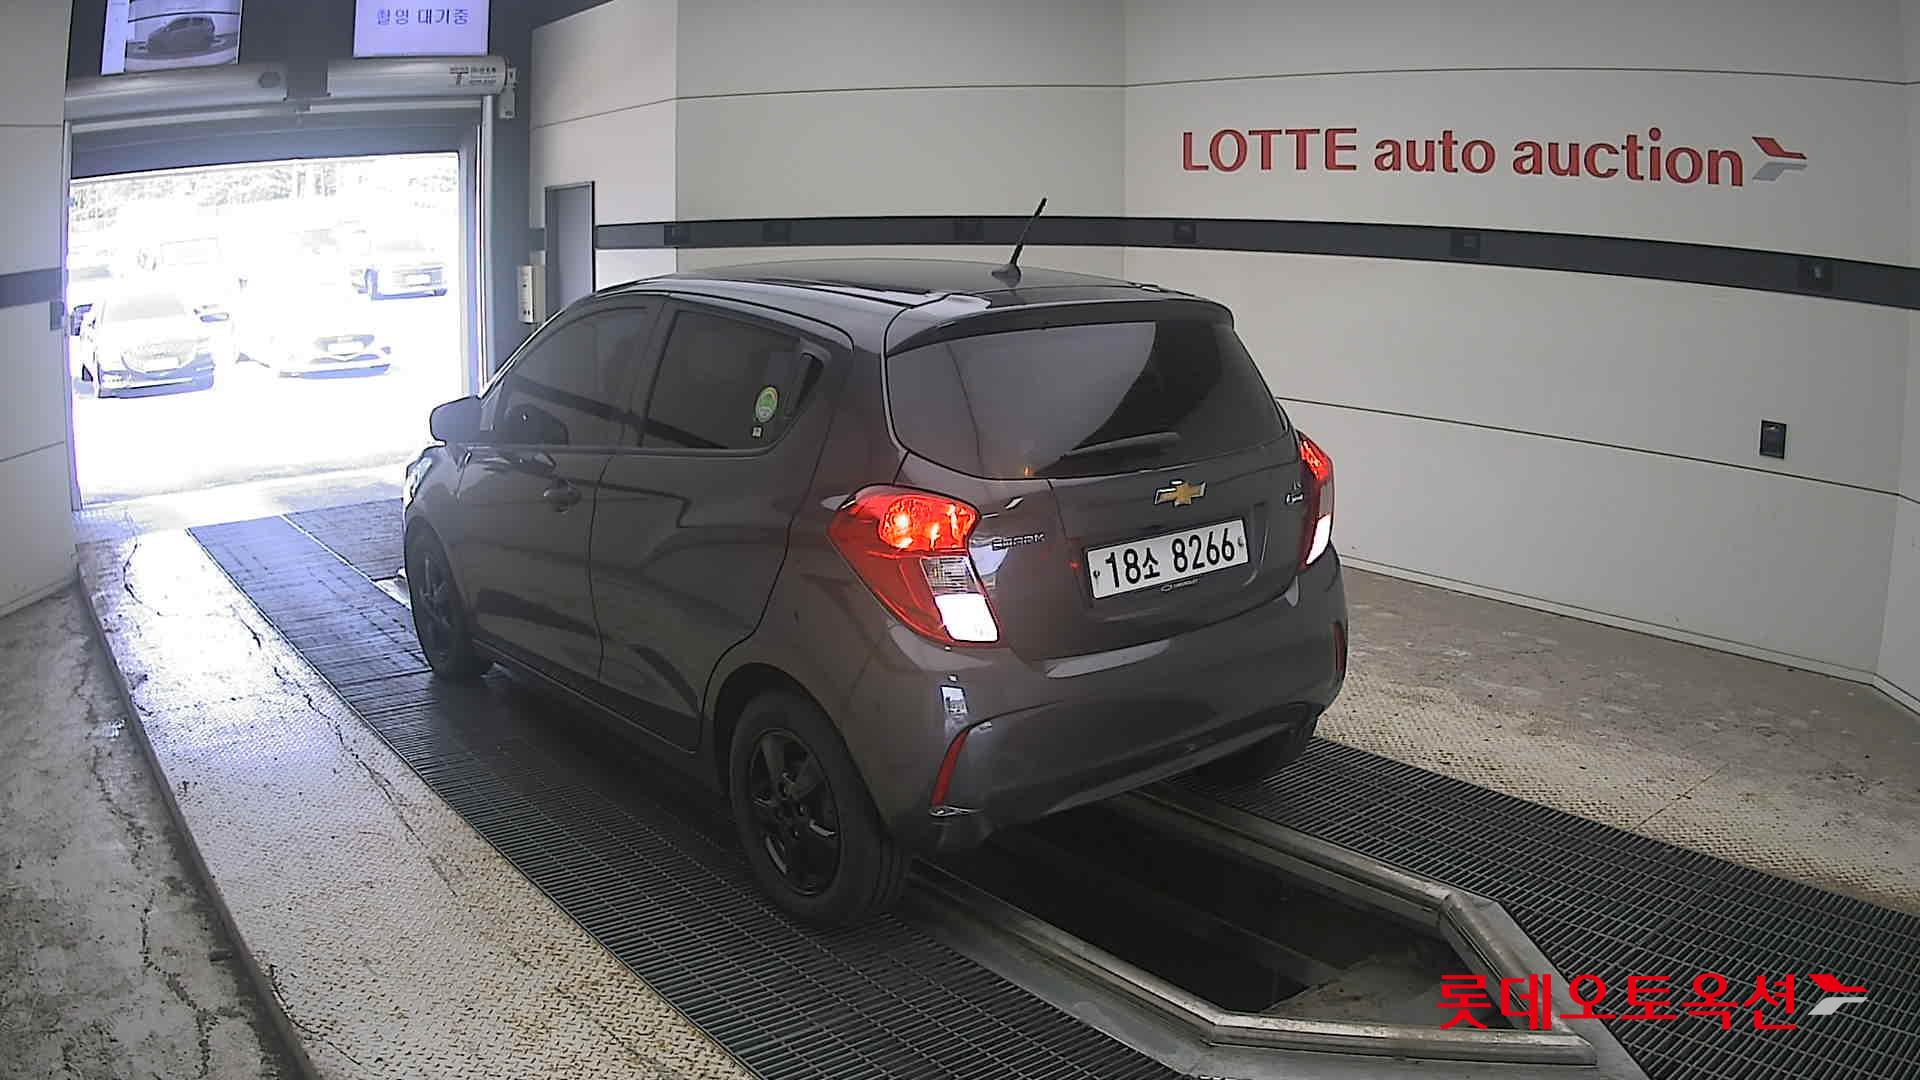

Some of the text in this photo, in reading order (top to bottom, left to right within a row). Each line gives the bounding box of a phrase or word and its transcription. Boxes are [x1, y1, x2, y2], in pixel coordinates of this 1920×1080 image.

[415, 8, 469, 25] 대기중
[1183, 127, 1743, 186] LOTTE auto auction
[1105, 527, 1235, 588] 18소 8266
